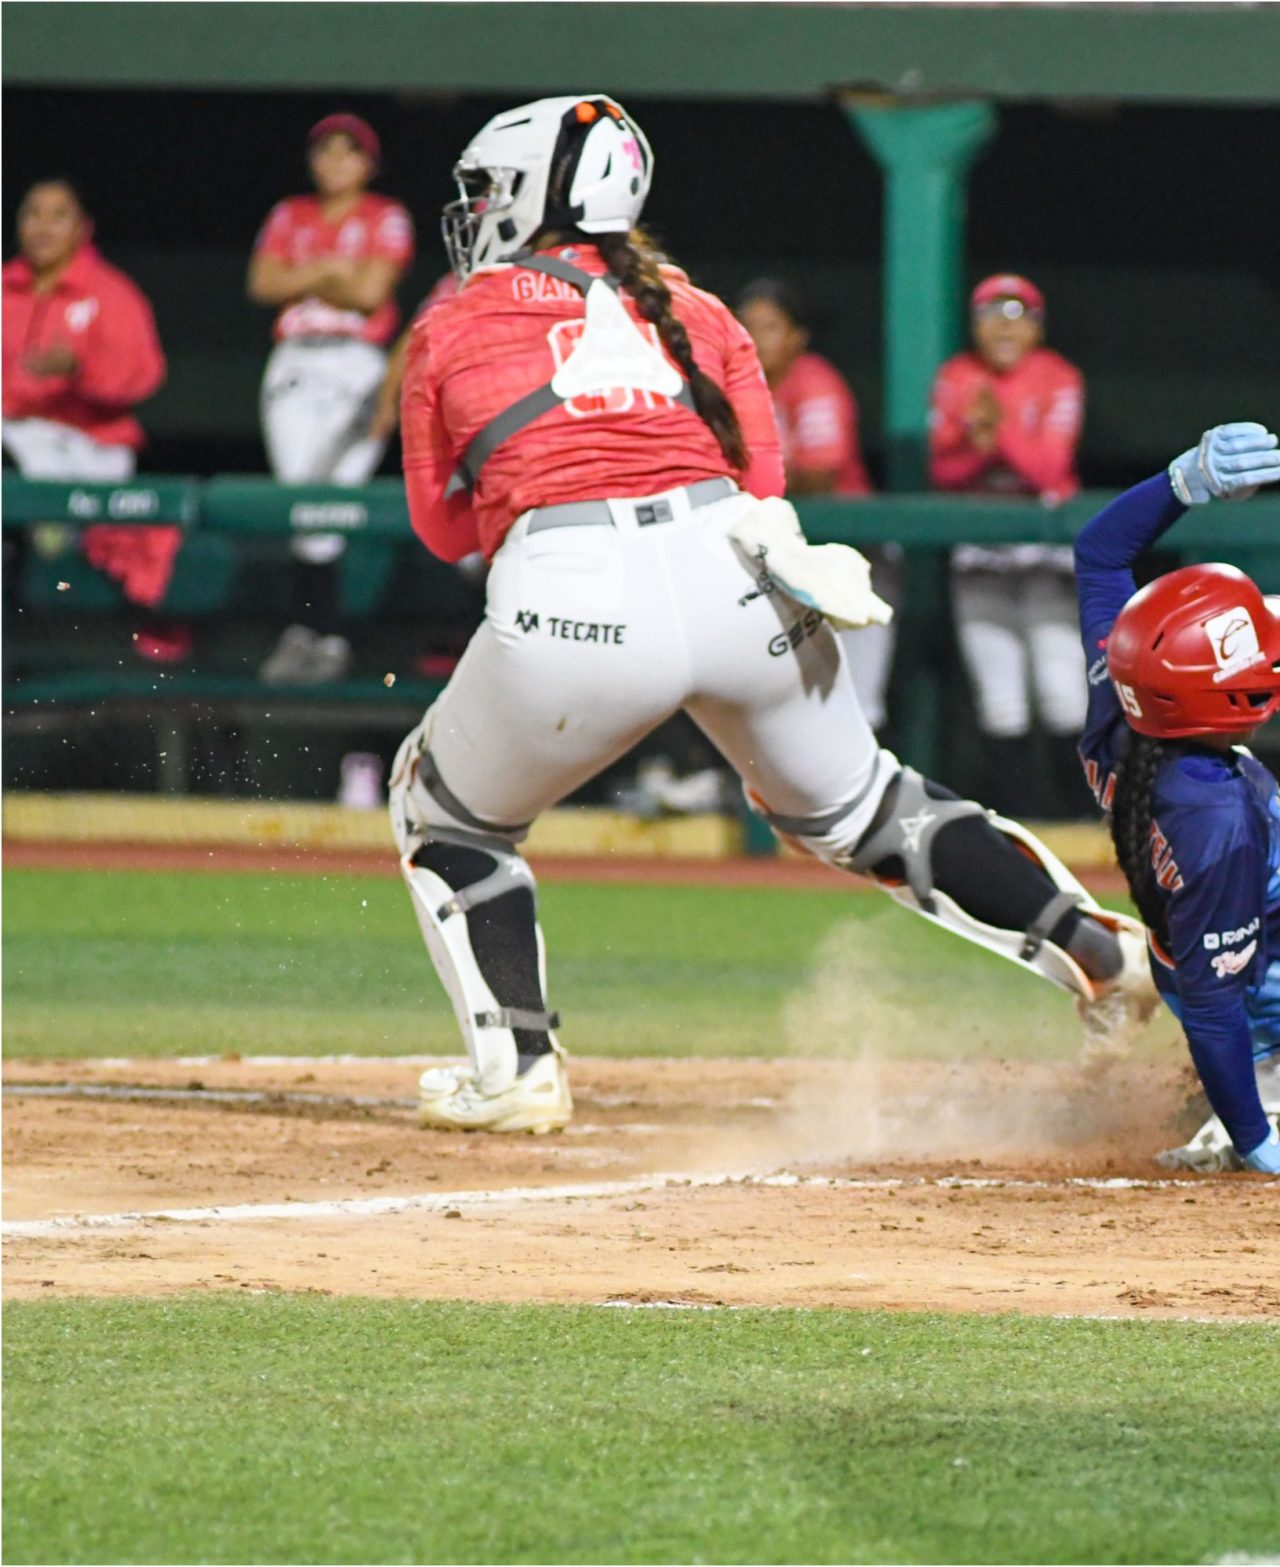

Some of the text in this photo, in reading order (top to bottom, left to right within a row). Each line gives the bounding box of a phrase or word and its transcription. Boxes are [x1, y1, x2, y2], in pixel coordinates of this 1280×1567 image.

[547, 617, 627, 645] TECATE
[768, 610, 825, 657] GES
[1114, 680, 1142, 719] 15
